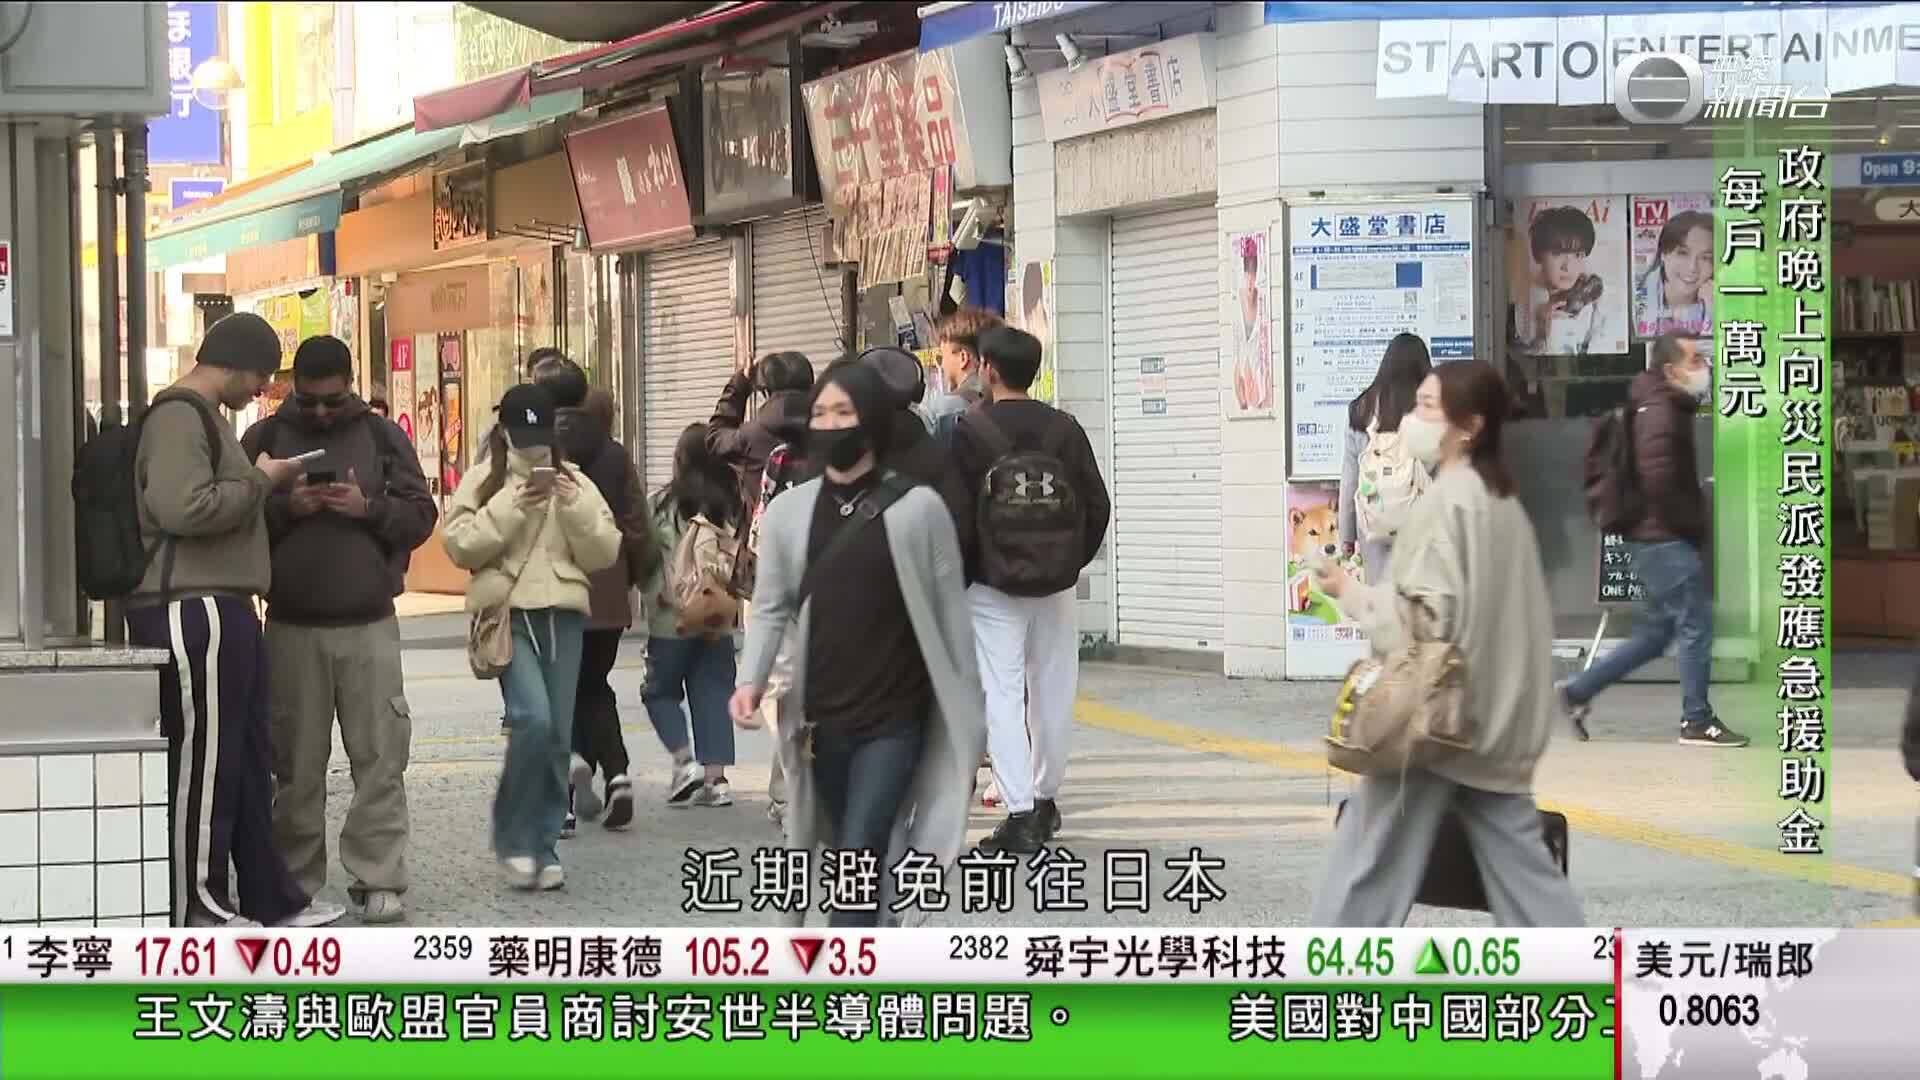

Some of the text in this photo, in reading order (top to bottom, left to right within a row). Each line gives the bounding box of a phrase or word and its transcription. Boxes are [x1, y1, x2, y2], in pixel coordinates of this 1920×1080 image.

[1636, 202, 1666, 219] TV
[1310, 213, 1446, 238] 大盛堂書店
[1602, 583, 1626, 597] ONE
